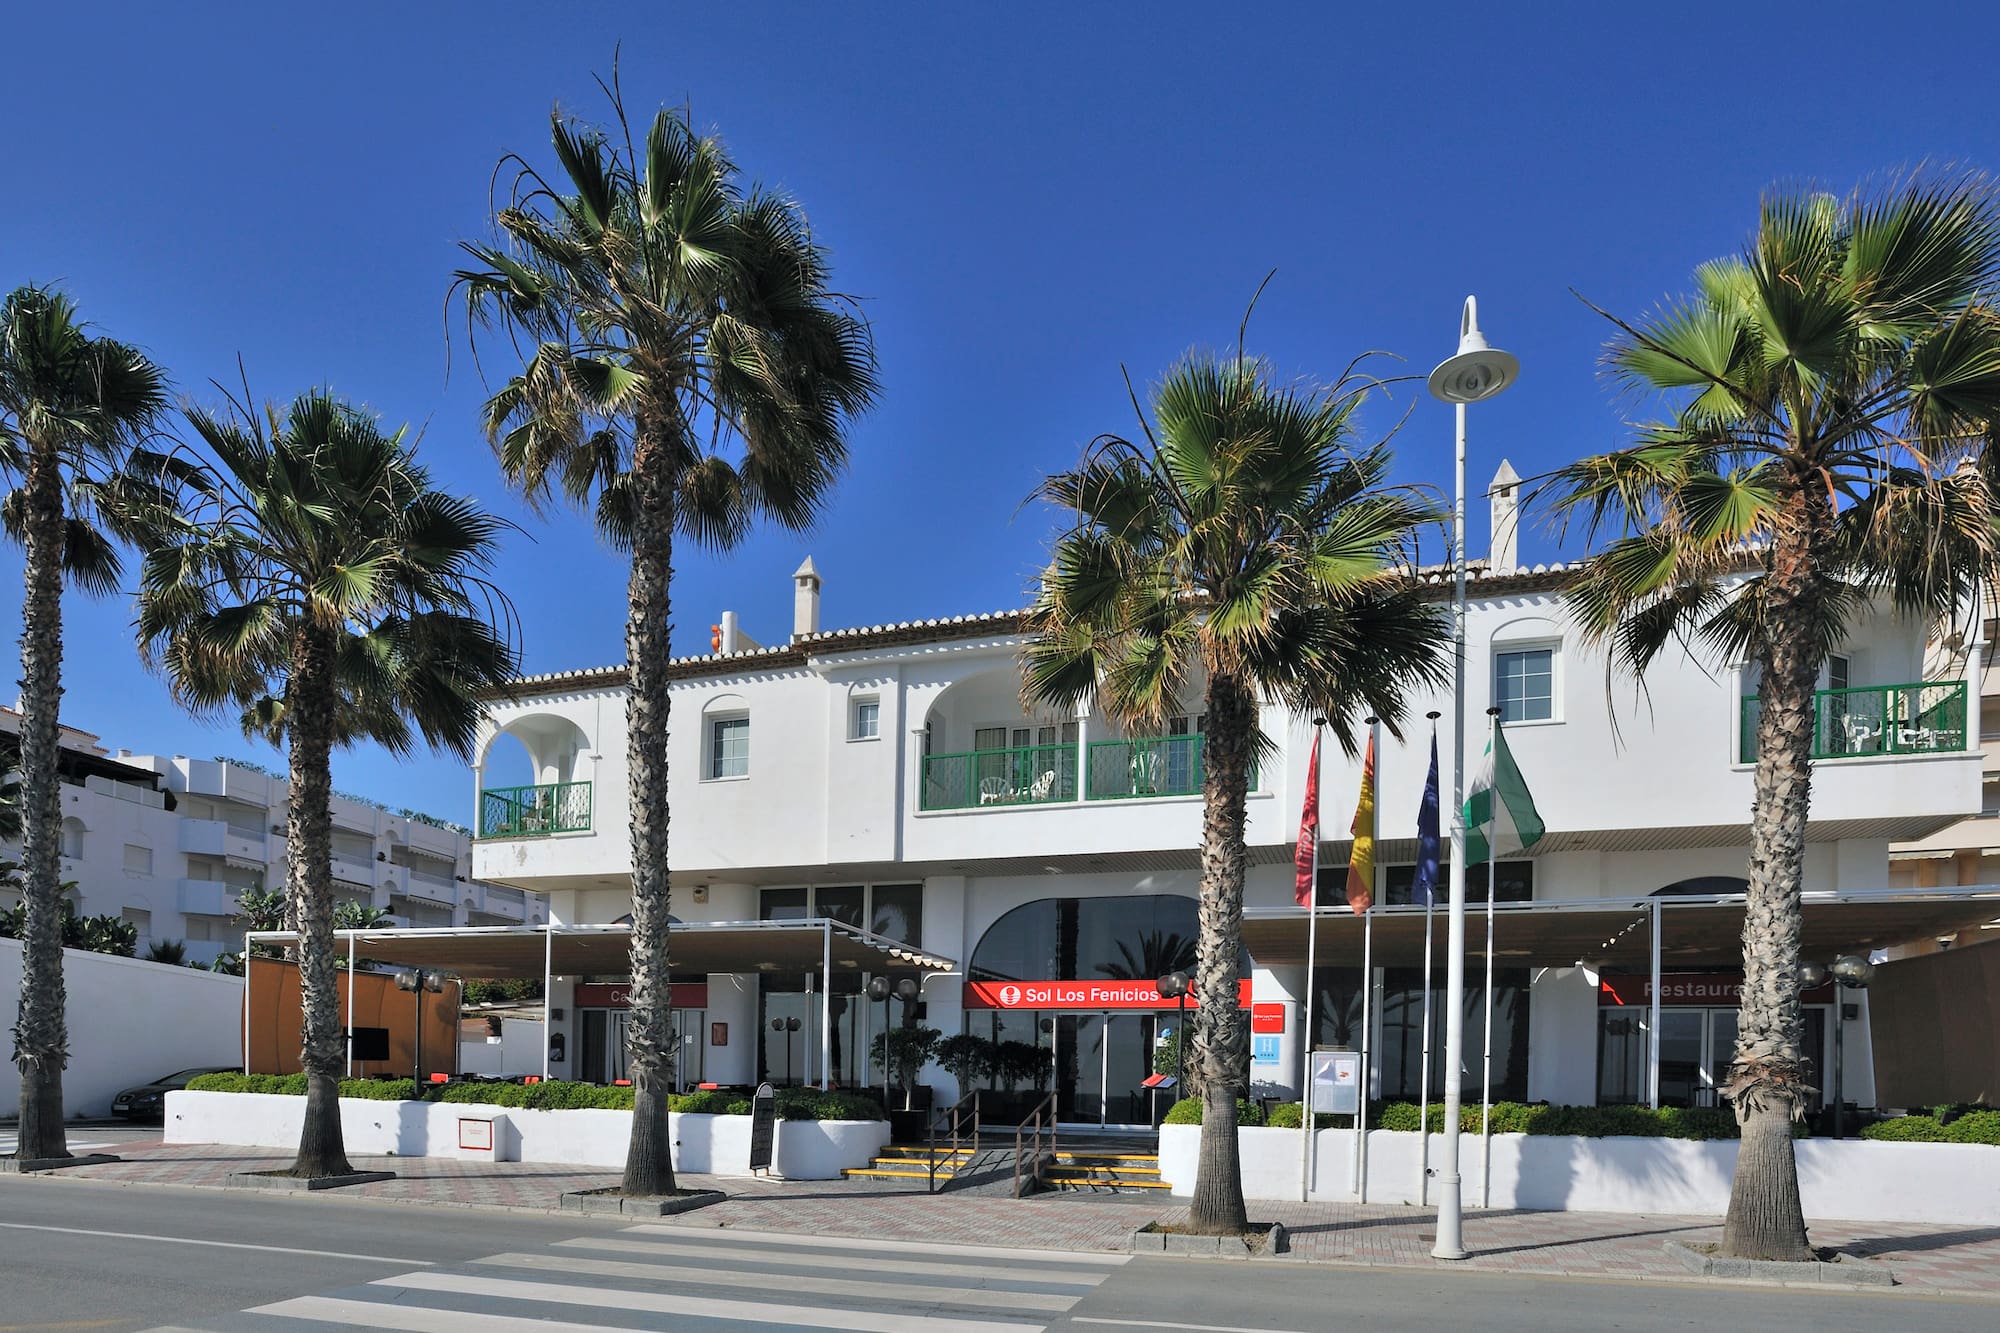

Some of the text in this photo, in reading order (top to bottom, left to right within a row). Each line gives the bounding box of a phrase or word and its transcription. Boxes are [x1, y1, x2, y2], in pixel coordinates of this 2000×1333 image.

[1026, 987, 1159, 1002] Sol Los Fenicios
[1644, 982, 1742, 997] Restaura
[1262, 1038, 1273, 1052] H
